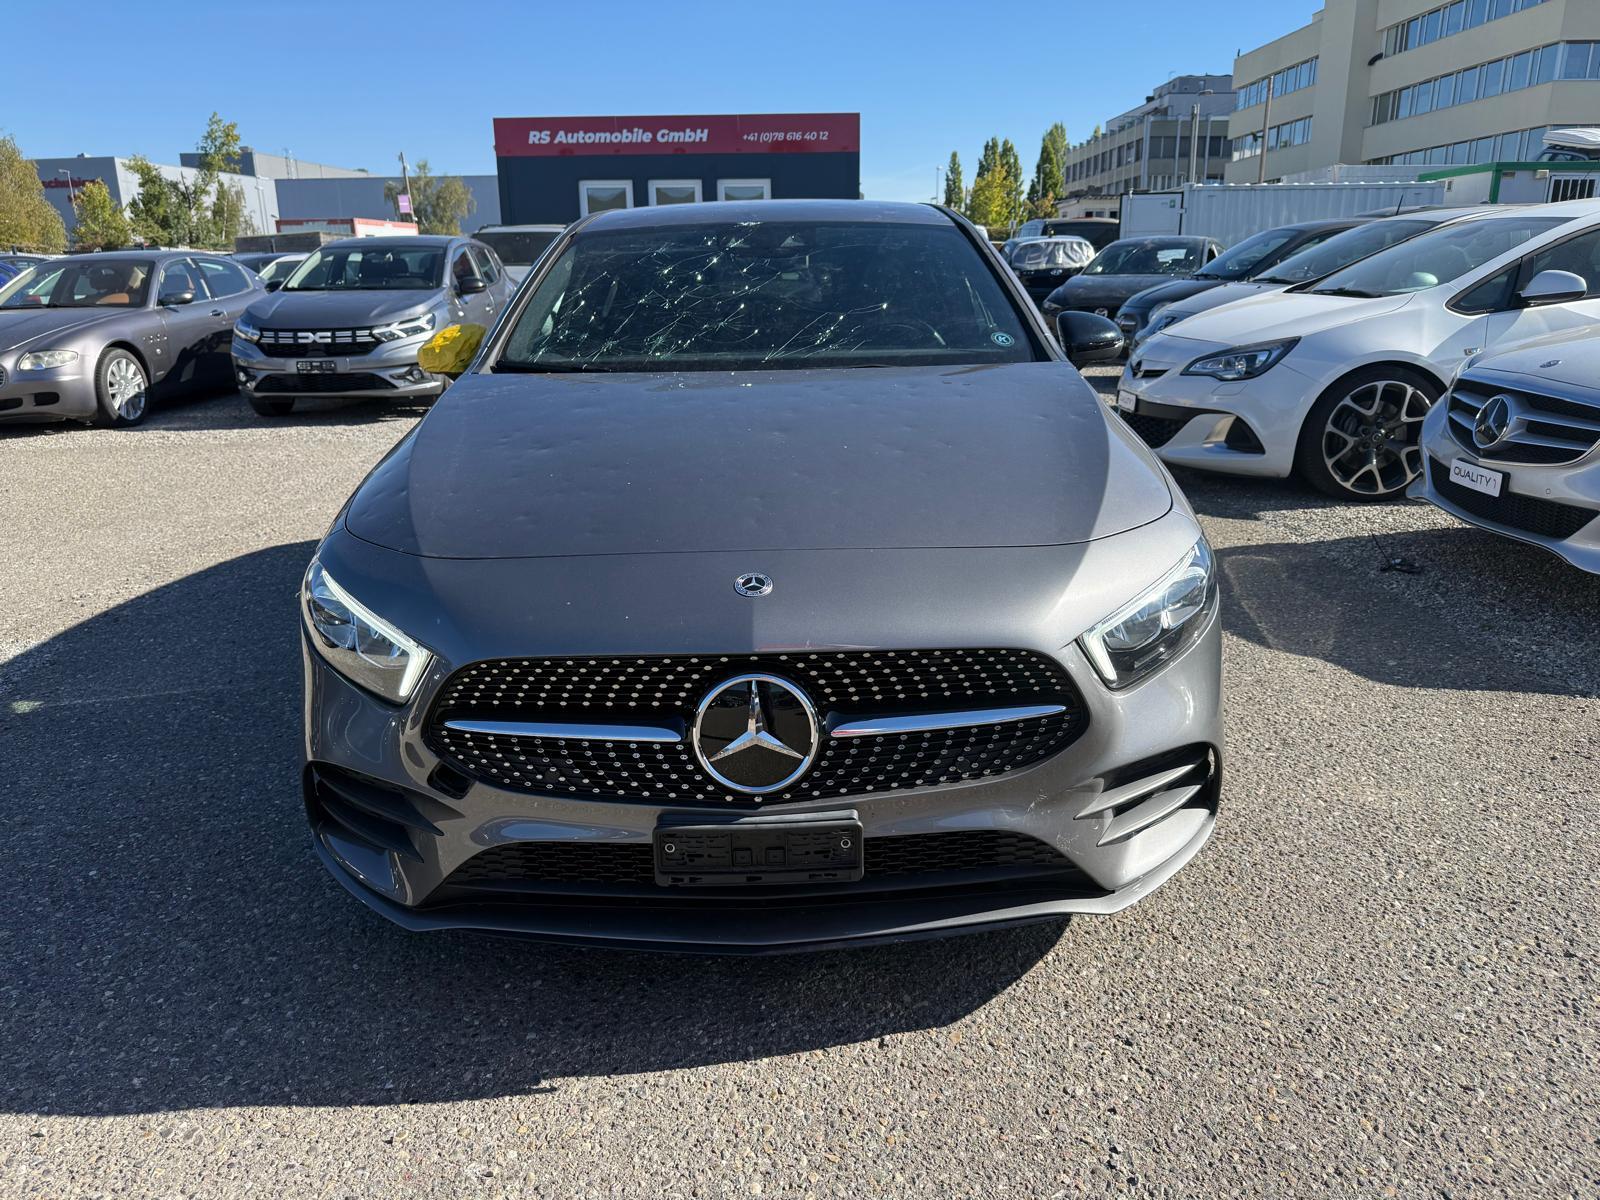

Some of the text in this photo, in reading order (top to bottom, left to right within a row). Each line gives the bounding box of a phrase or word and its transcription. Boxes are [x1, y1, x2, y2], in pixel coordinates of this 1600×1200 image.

[528, 128, 709, 145] RS Automobile GmbH
[743, 131, 829, 143] +41 (0)78 616 40 12
[1453, 466, 1492, 487] QUALITY
